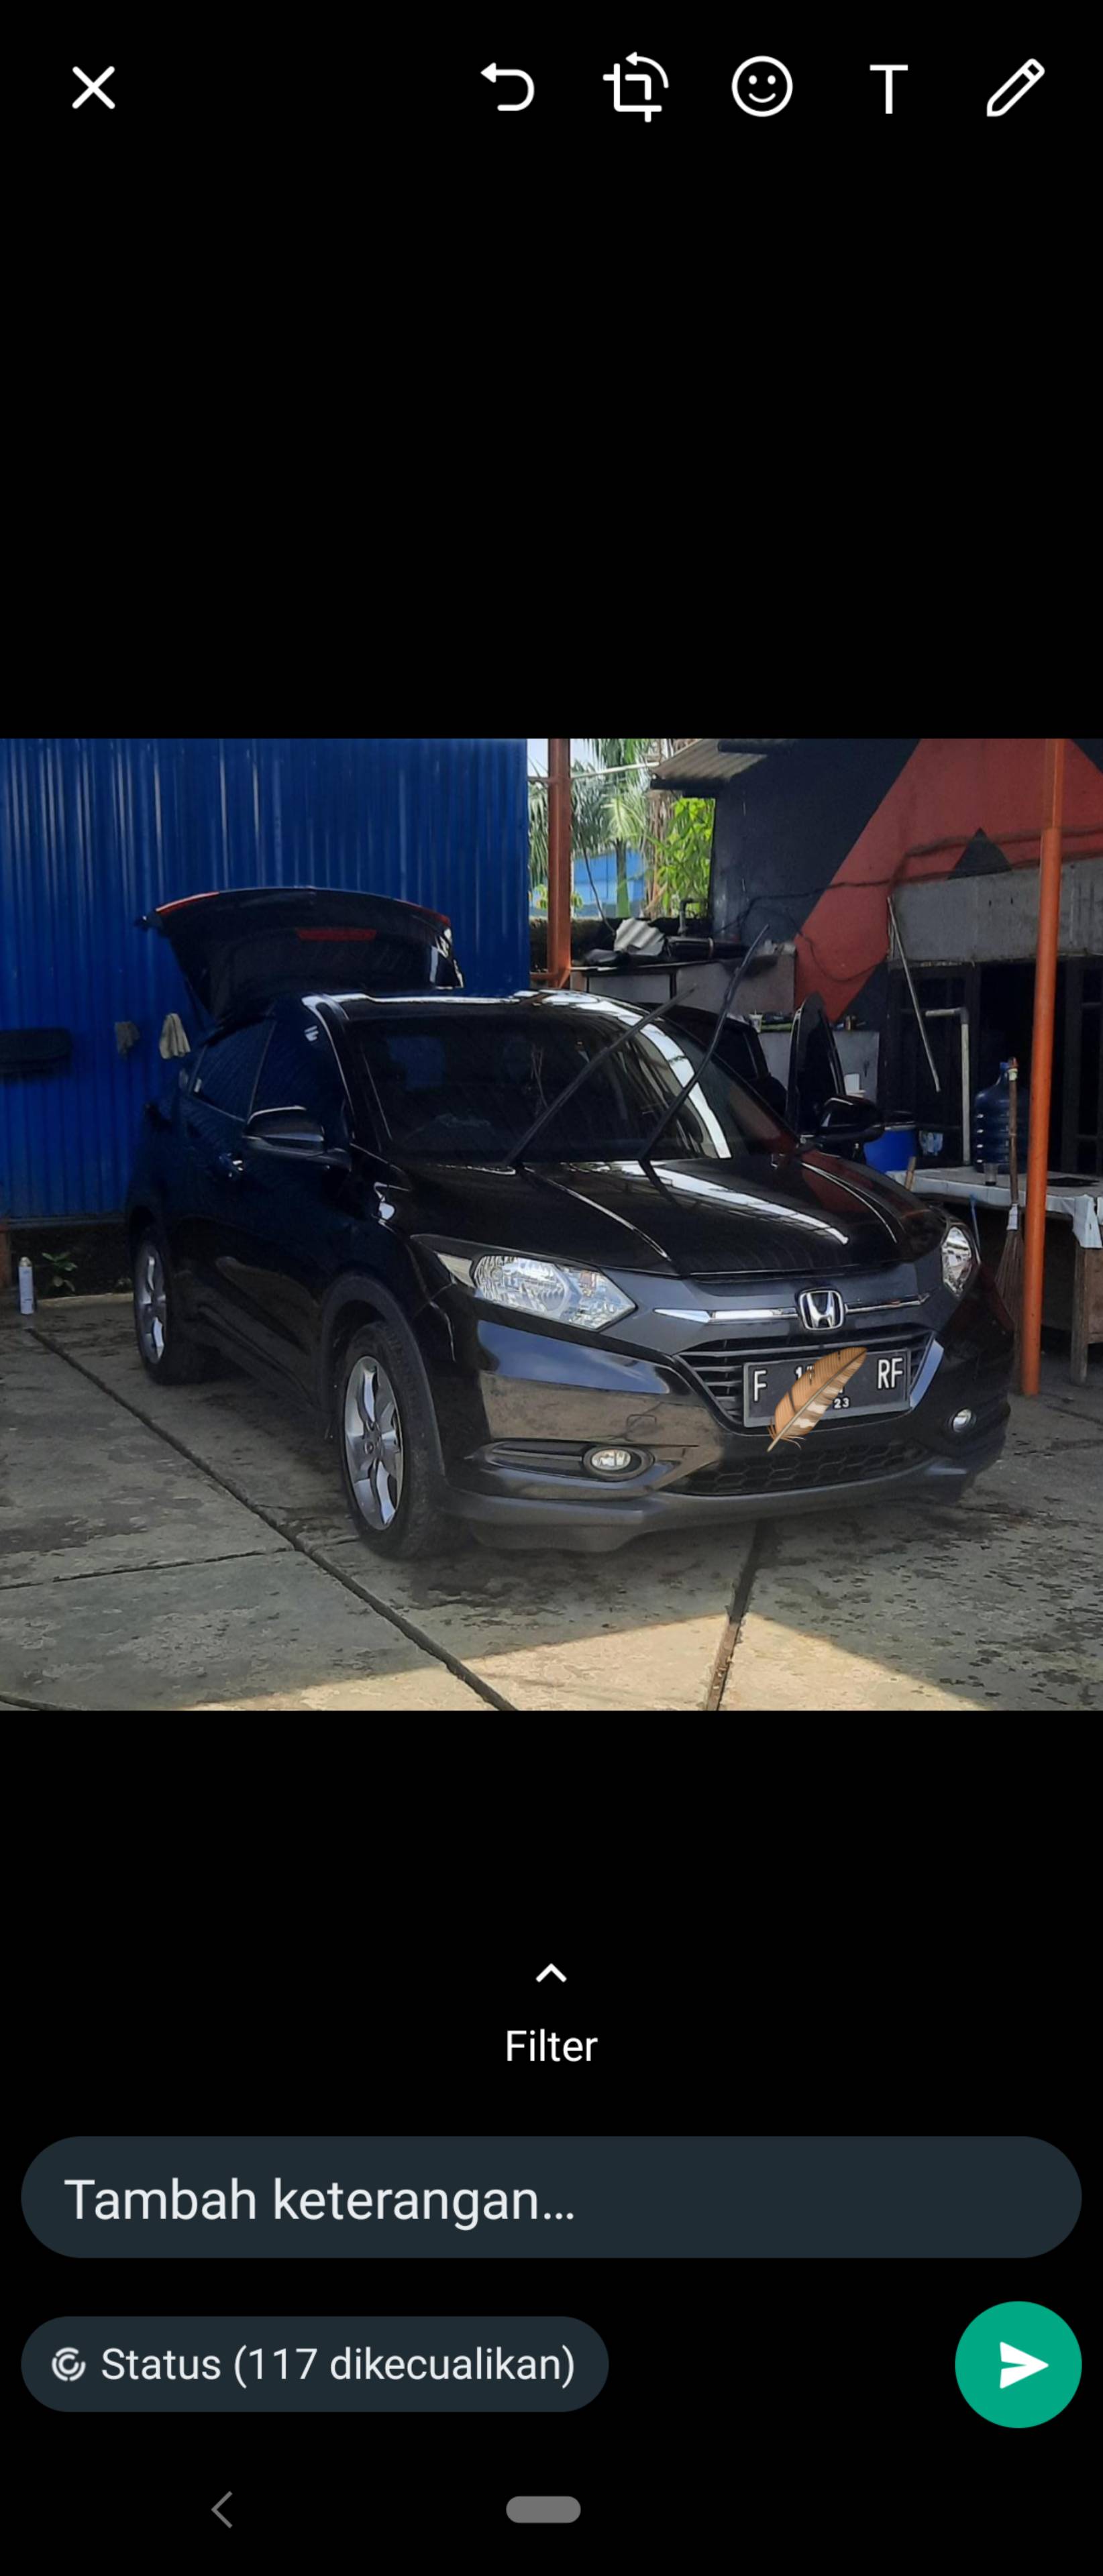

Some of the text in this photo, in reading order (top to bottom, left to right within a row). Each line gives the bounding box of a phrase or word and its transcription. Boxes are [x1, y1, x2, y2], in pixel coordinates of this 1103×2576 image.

[754, 1370, 767, 1401] F
[878, 1358, 903, 1389] RF
[834, 1397, 850, 1409] 23
